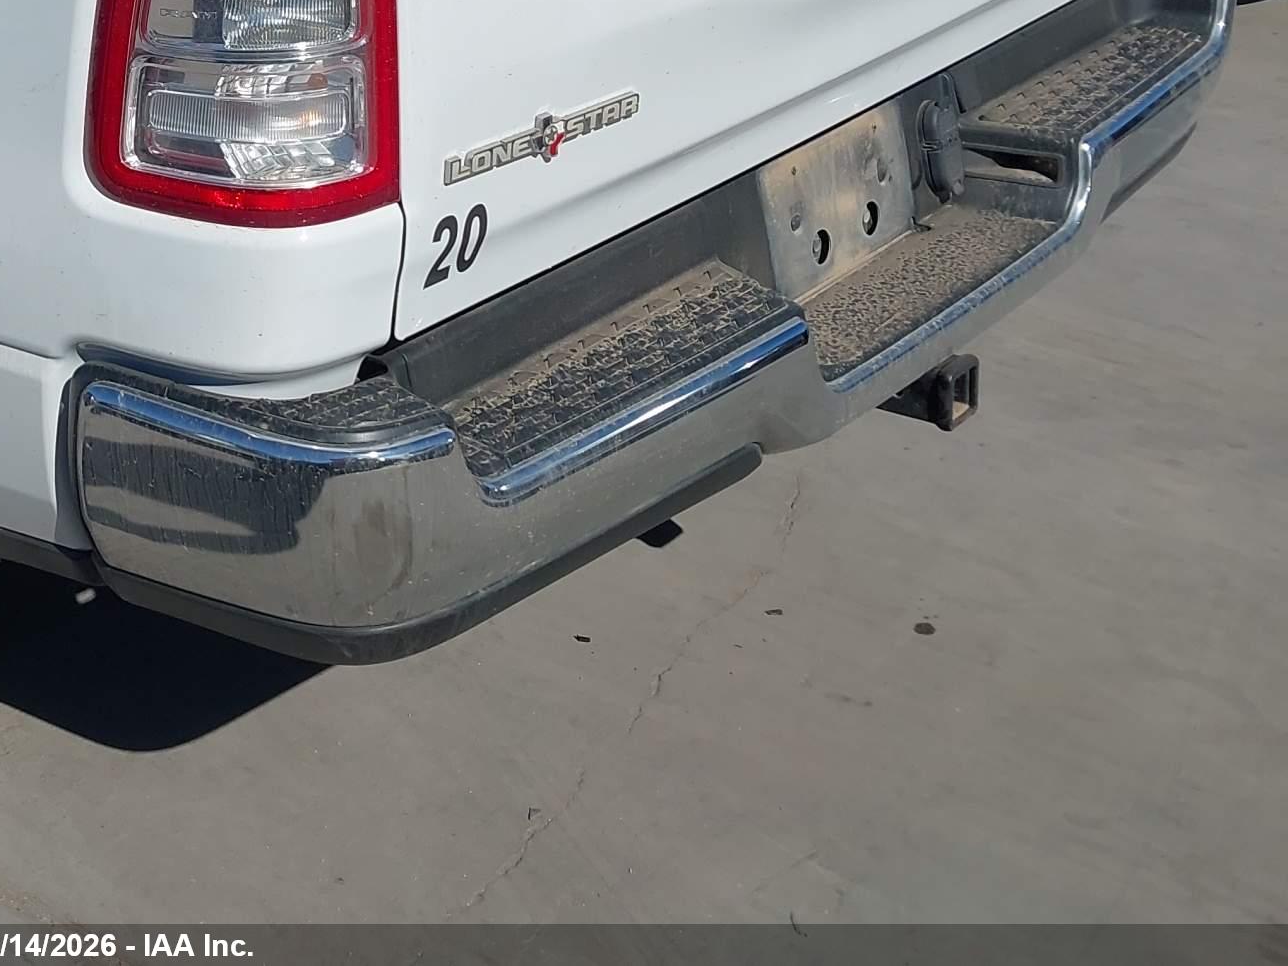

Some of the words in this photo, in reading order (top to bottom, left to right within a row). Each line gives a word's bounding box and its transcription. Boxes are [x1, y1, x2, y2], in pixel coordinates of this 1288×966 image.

[445, 132, 533, 186] LONE
[564, 92, 640, 140] STAR
[423, 203, 488, 290] 20
